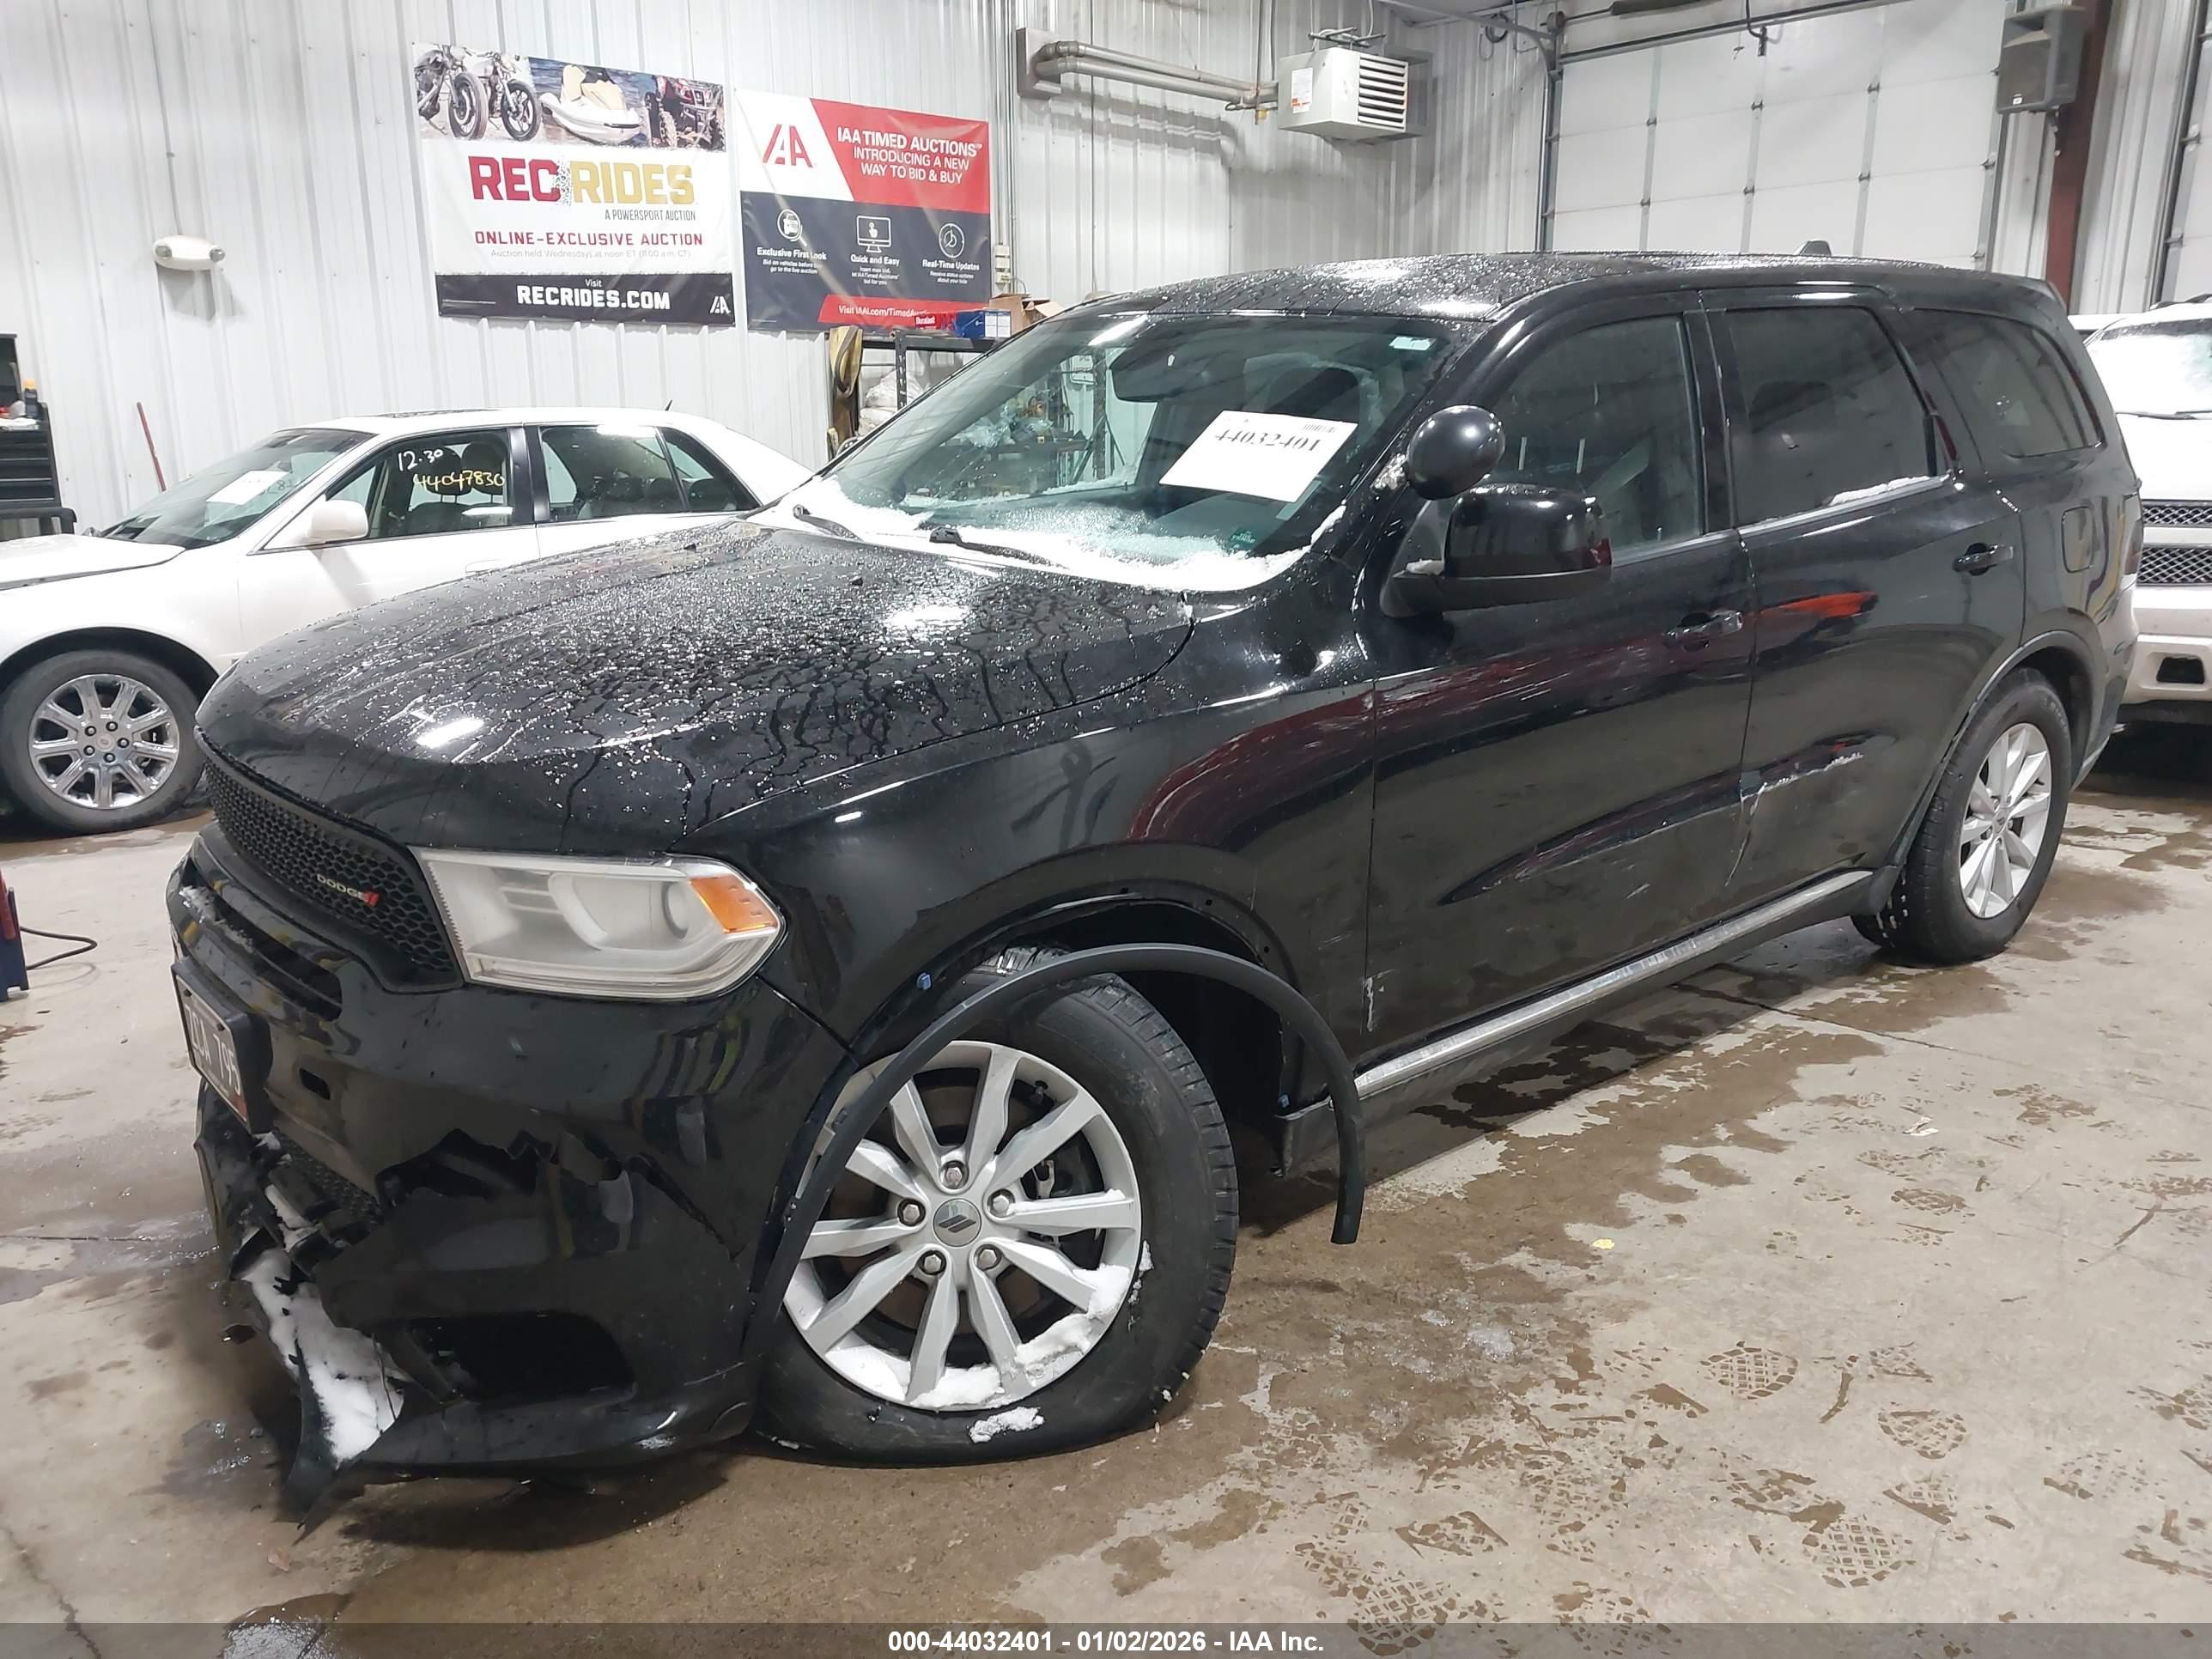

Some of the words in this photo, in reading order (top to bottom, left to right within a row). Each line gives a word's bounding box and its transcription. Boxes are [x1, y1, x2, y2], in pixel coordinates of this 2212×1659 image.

[837, 126, 861, 144] IAA
[862, 130, 908, 149] TIMED
[854, 146, 931, 167] INTRODUCING
[933, 156, 942, 168] A
[944, 156, 969, 171] NEW
[468, 155, 562, 203] REC
[569, 161, 695, 205] RIDES
[860, 162, 888, 176] WAY
[890, 164, 907, 178] TO
[908, 167, 927, 180] BID
[928, 169, 938, 182] &
[939, 171, 963, 184] BUY
[605, 210, 611, 221] A
[612, 210, 663, 221] POWERSPORT
[665, 210, 696, 222] AUCTION
[475, 230, 634, 246] ONLINE-EXCLUSIVE
[641, 233, 703, 246] AUCTION
[491, 249, 523, 258] Auction
[525, 249, 542, 258] held
[757, 246, 792, 258] Exclusive
[793, 249, 809, 259] First
[810, 250, 827, 260] Look
[850, 254, 868, 264] Quick
[884, 257, 900, 267] Easy
[922, 259, 955, 270] Real-Time
[956, 262, 980, 272] Updates
[585, 279, 603, 289] Visit
[516, 284, 671, 310] RECRIDES.COM
[838, 305, 854, 315] Visit
[1214, 428, 1322, 451] 44032401
[412, 470, 506, 491] 44047830
